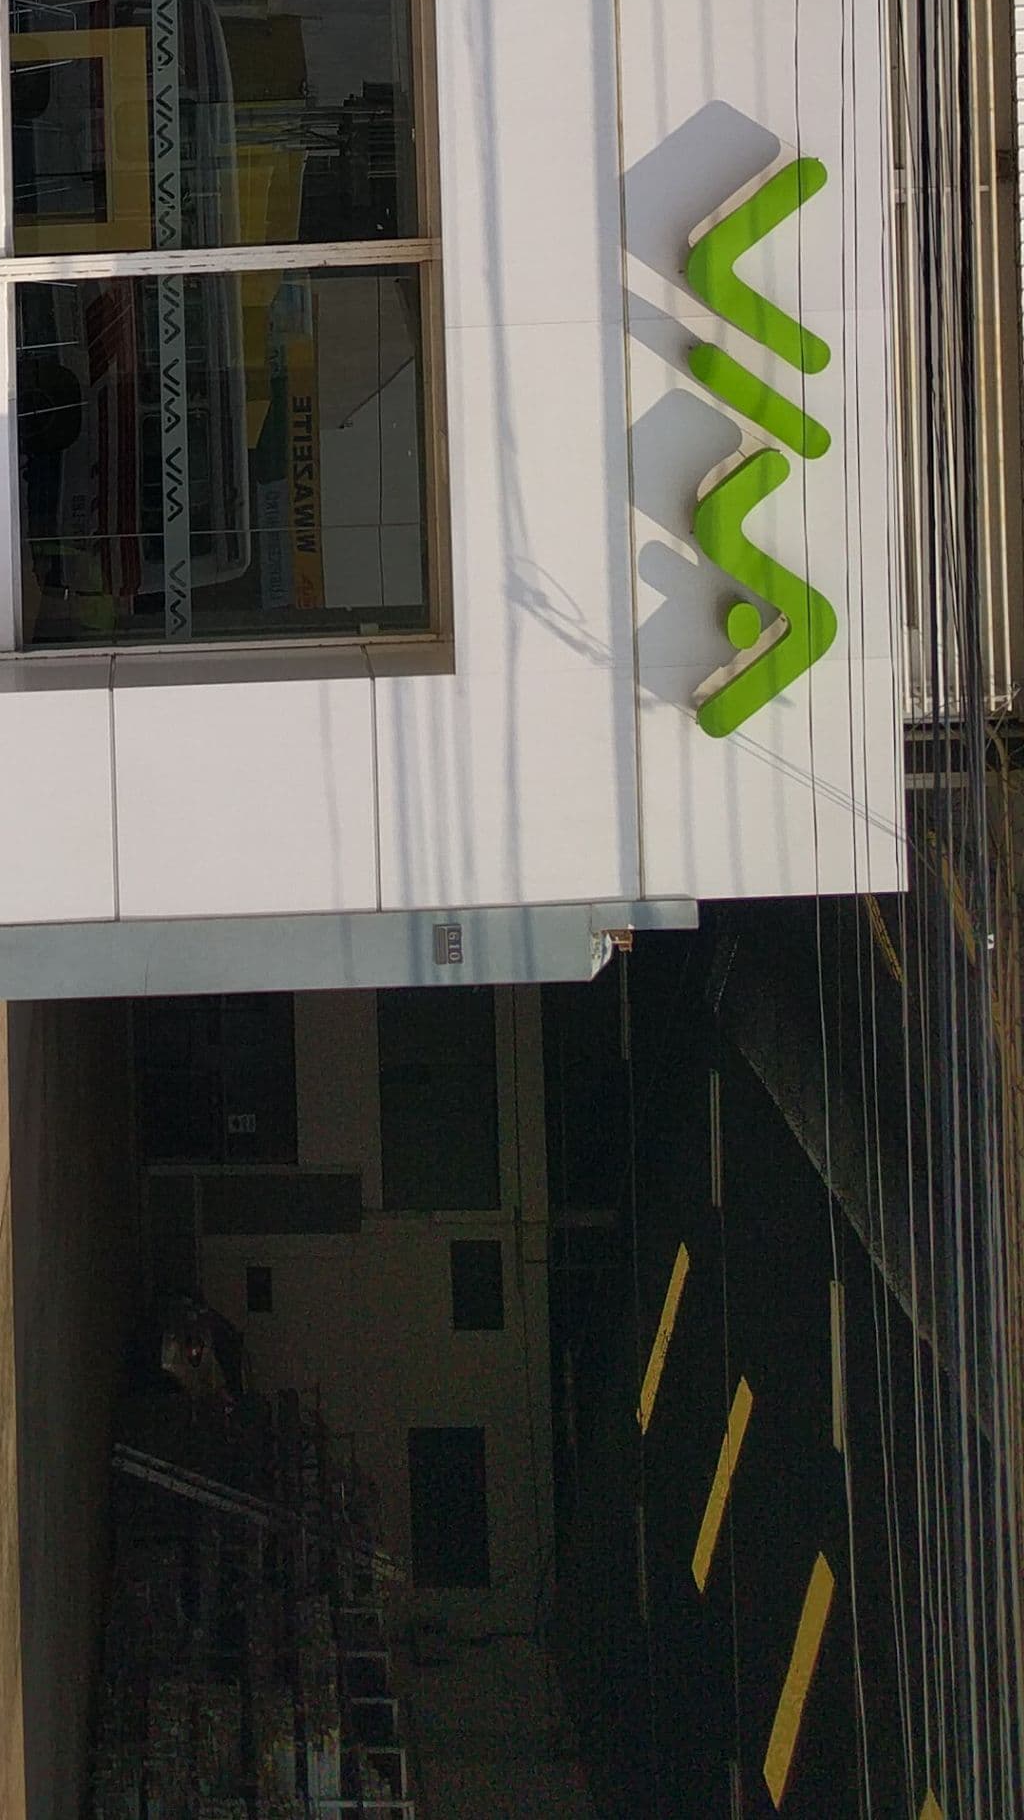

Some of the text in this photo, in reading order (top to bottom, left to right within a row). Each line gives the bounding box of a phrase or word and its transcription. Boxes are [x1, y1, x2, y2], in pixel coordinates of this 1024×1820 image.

[156, 85, 175, 159] VIVA
[157, 172, 177, 247] VIVA
[162, 276, 187, 635] VIVA VIVA VIVA VIVA
[686, 157, 838, 738] VIVA
[447, 931, 461, 961] 610
